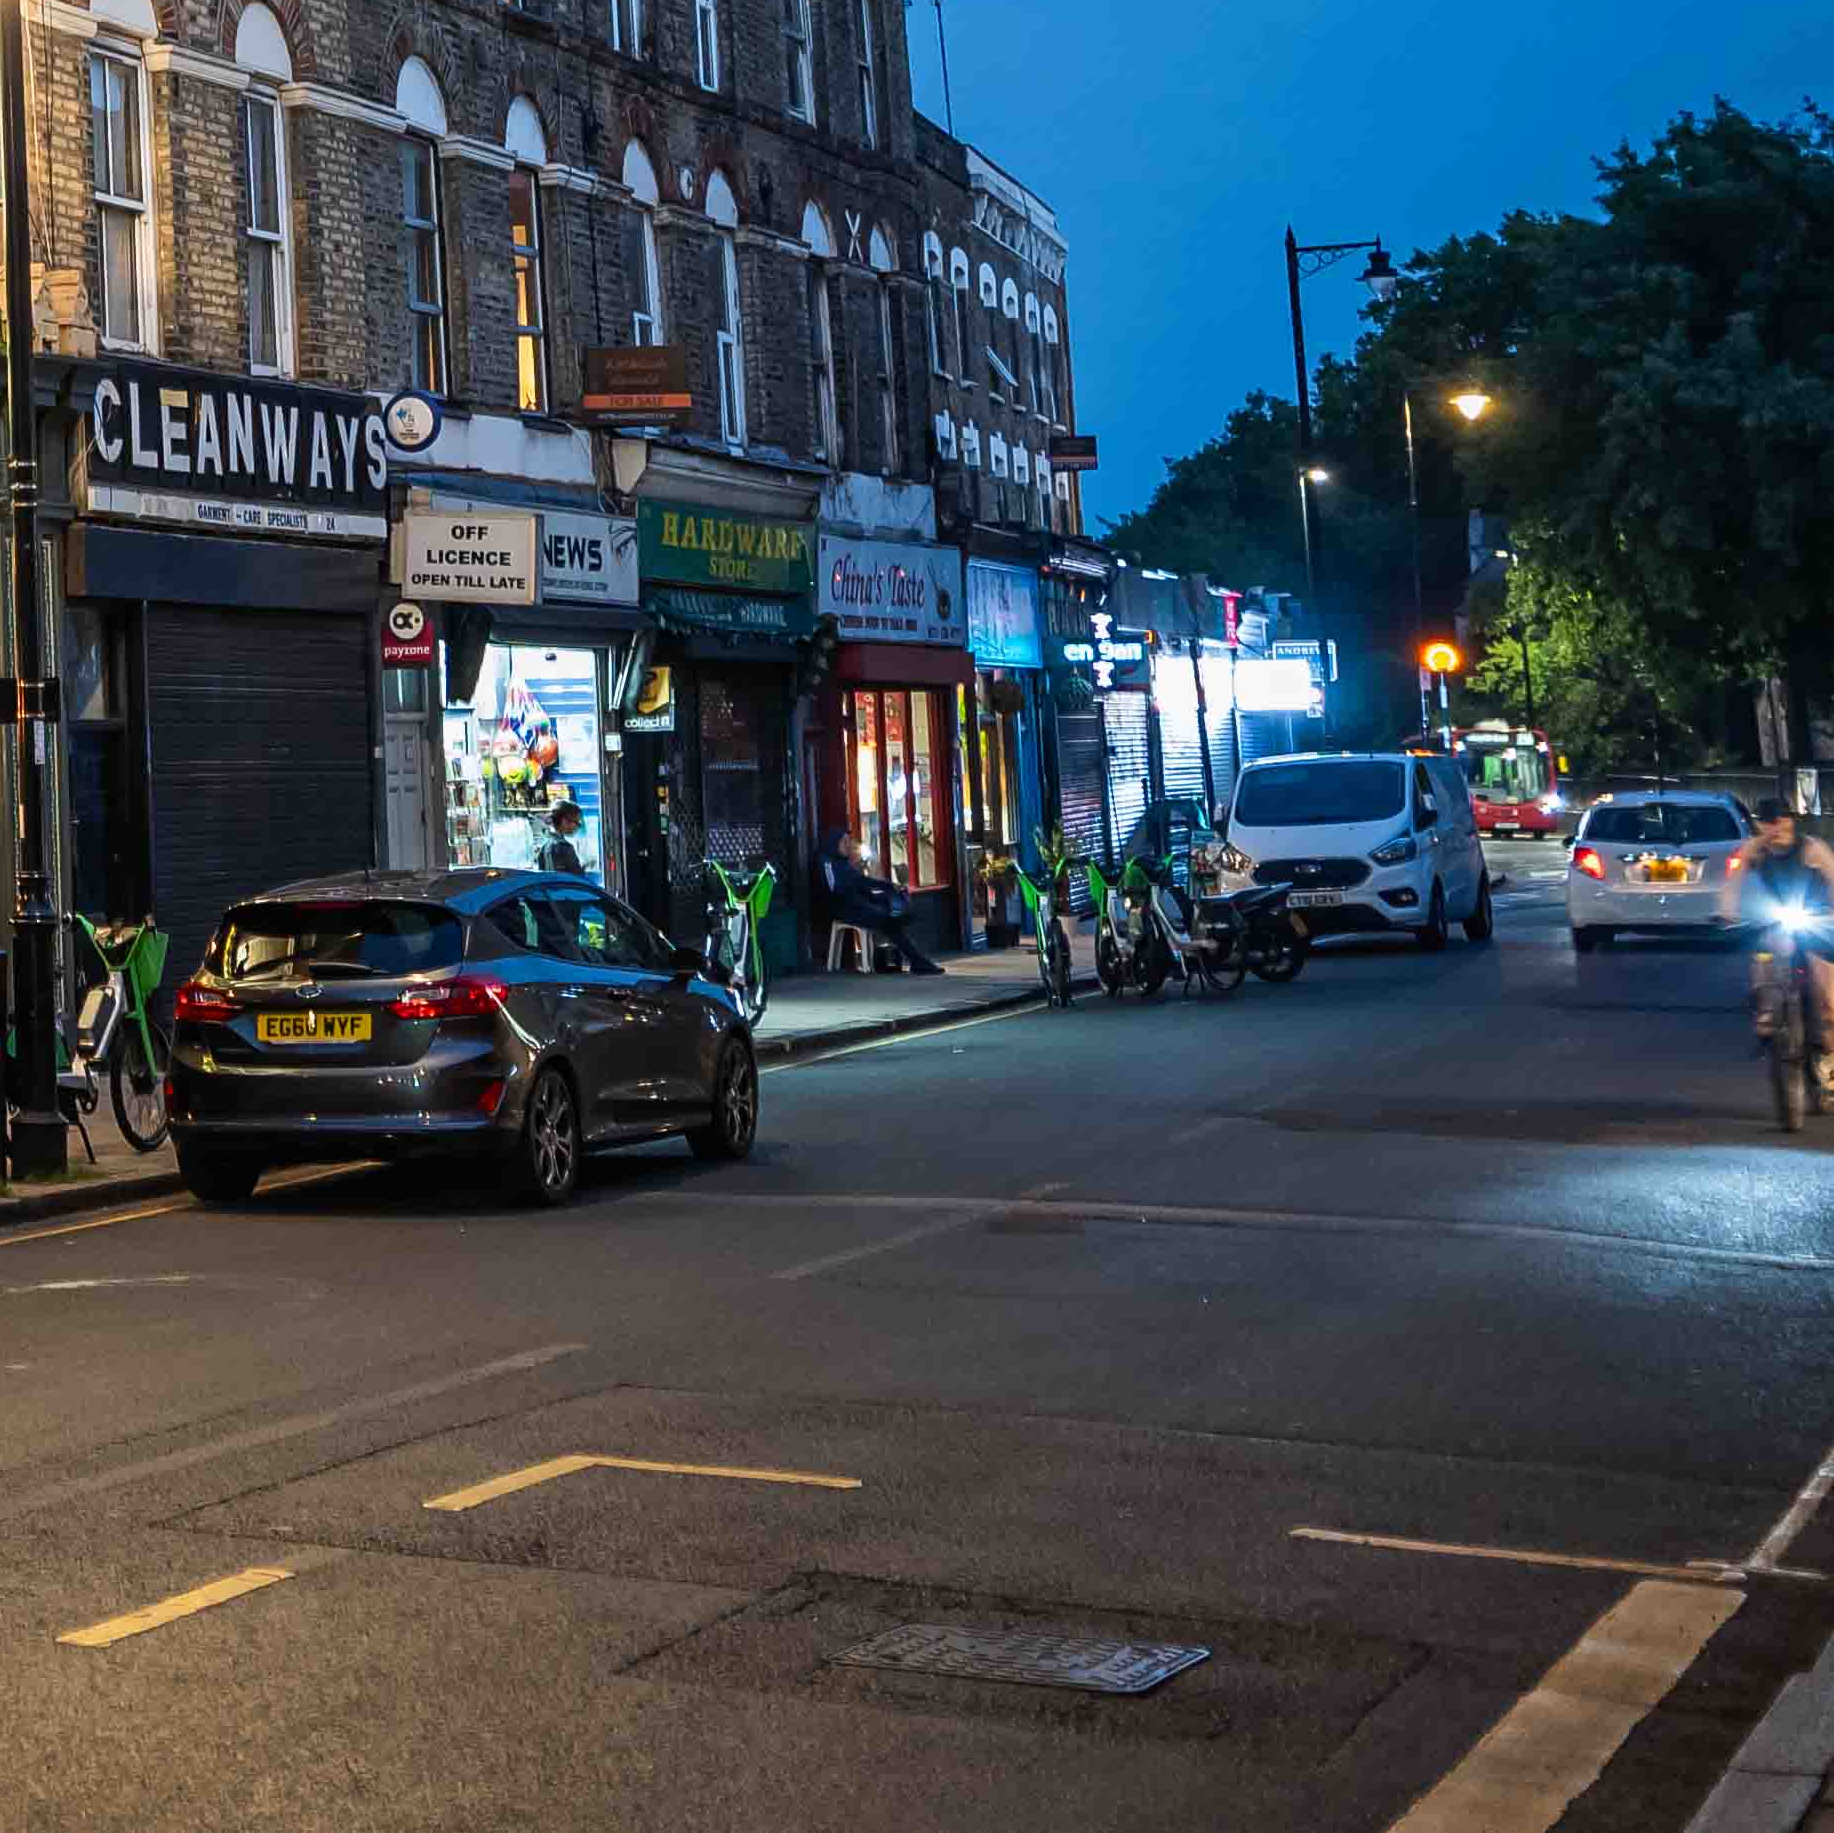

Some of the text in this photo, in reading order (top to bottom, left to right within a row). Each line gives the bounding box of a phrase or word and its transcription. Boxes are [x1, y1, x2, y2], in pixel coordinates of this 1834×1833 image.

[93, 377, 387, 493] CLEANWAYS
[197, 503, 231, 521] GARMENT
[243, 506, 262, 525] CARE
[450, 525, 489, 541] OFF
[426, 549, 511, 567] LICENCE
[411, 573, 526, 590] OPEN TILL LATE
[888, 562, 926, 608] Taste
[384, 644, 430, 659] payzone
[324, 1016, 364, 1038] WYF
